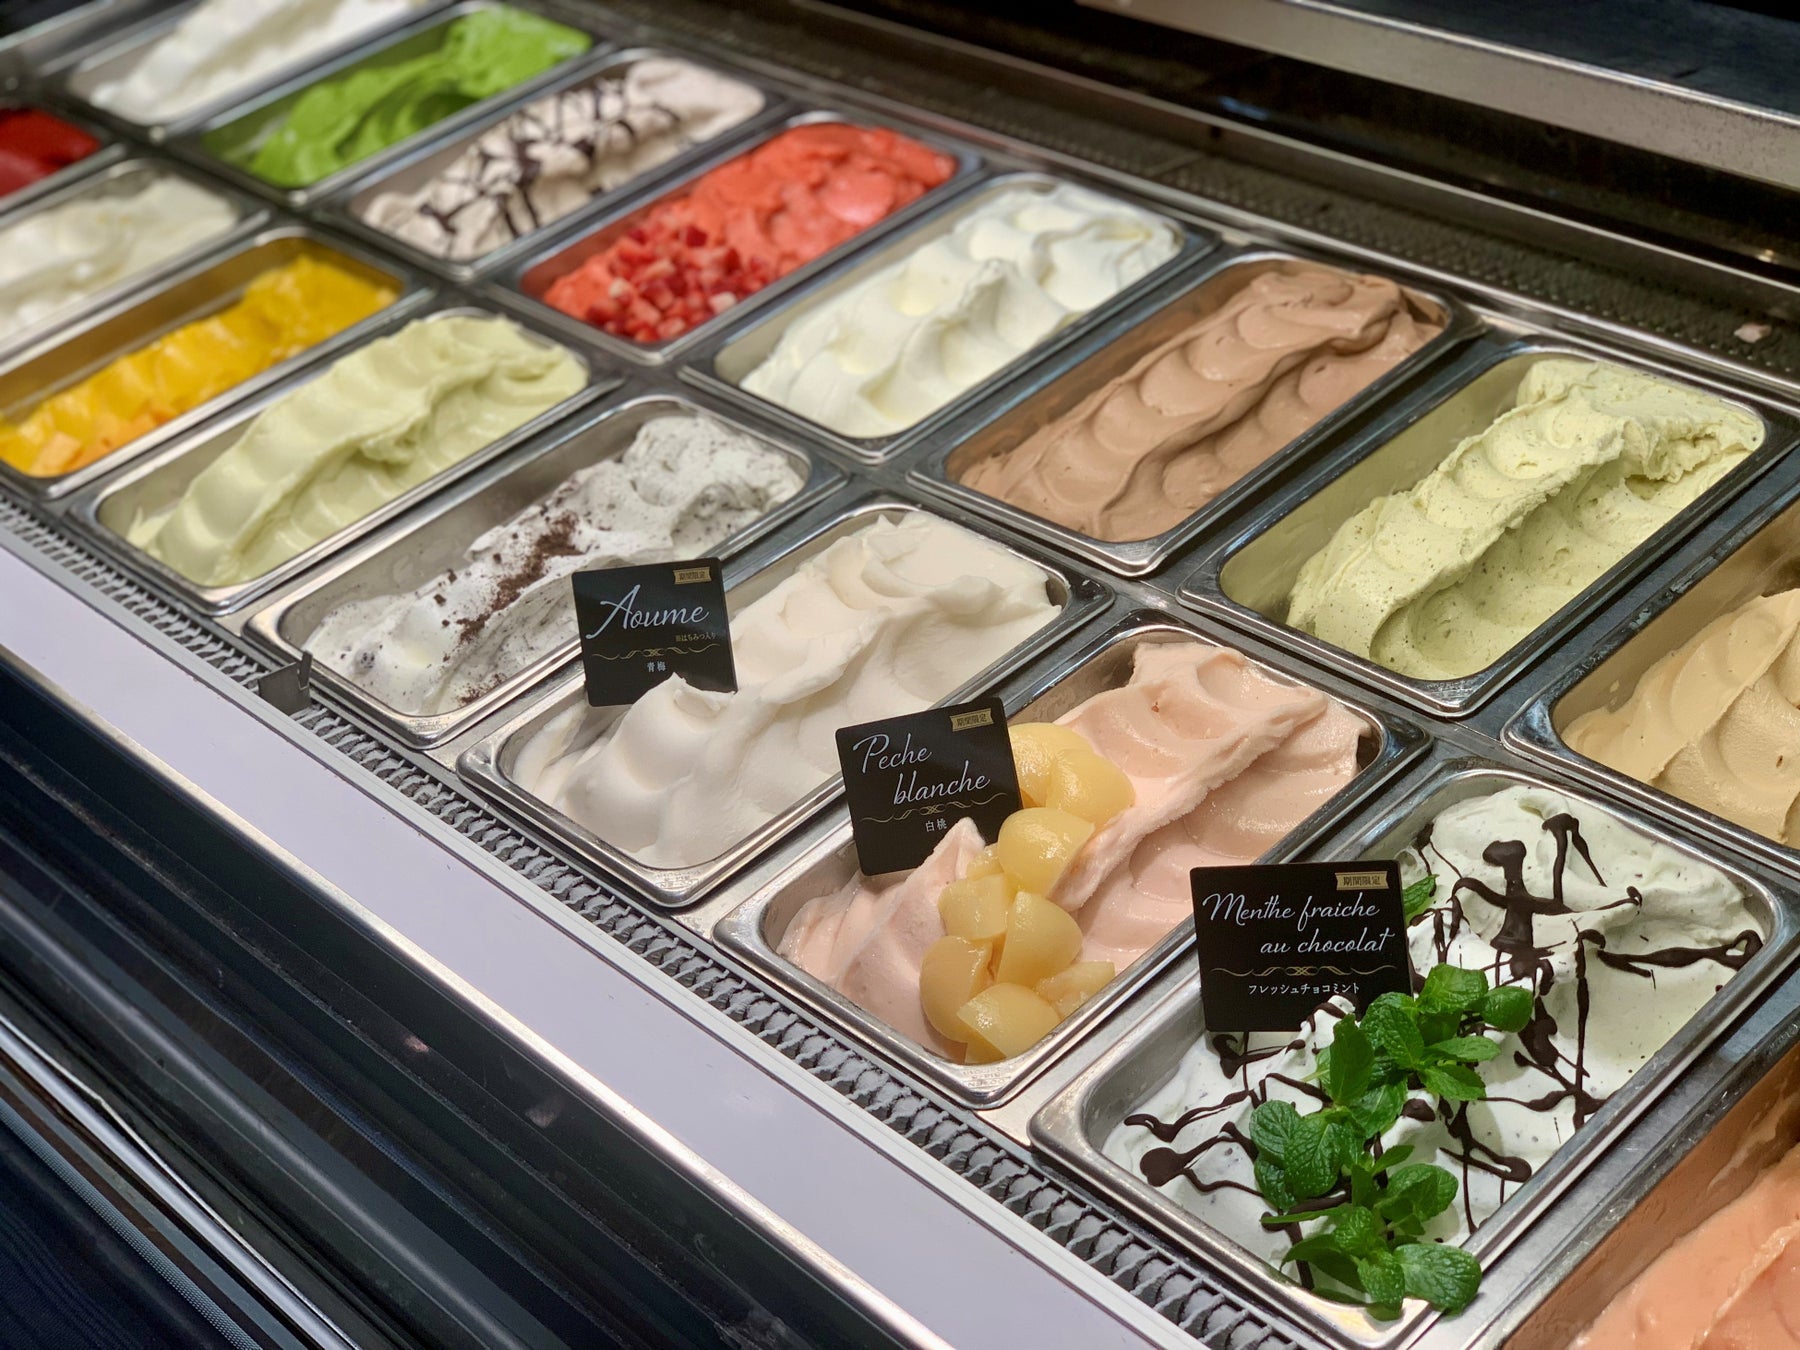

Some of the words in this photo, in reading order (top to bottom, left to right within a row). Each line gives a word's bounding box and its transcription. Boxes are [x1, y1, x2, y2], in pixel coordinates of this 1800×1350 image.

[585, 584, 709, 640] Aoume
[646, 661, 667, 673] 青梅
[852, 733, 932, 774] Peche
[893, 760, 991, 805] blanche
[925, 818, 948, 833] 白桃
[1202, 892, 1296, 926] Menthe
[1297, 892, 1380, 932] fraiche
[1260, 940, 1291, 954] au
[1297, 927, 1396, 954] chocolat
[1248, 982, 1360, 995] フレッシュチョコミント
